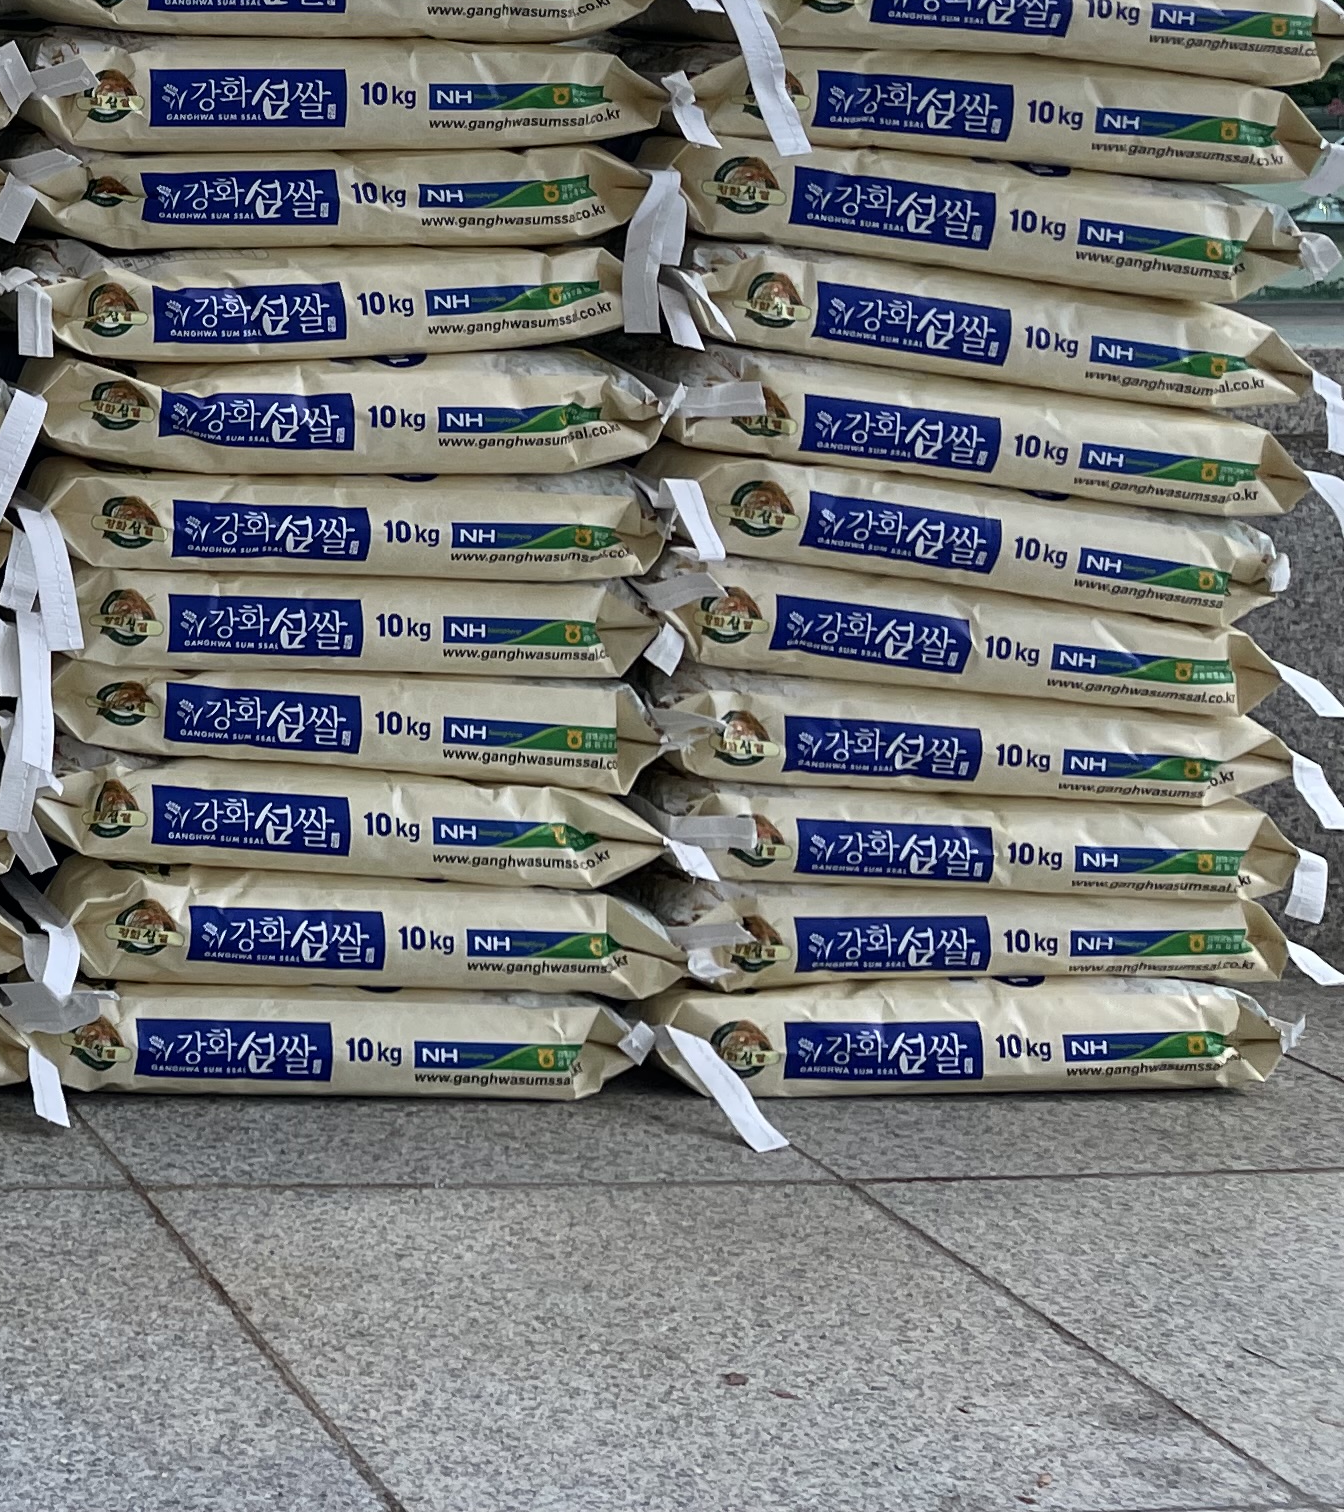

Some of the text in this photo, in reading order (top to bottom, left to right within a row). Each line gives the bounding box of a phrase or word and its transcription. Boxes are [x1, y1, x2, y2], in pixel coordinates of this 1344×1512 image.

[166, 113, 262, 121] GANGHWA SUM SSAL
[190, 76, 332, 119] 강화섬쌀
[436, 90, 472, 104] NH
[857, 83, 997, 132] 강화섬쌀
[1103, 113, 1140, 130] NH
[194, 293, 332, 335] 강화섬쌀
[433, 294, 470, 310] NH
[839, 412, 985, 464] 강화섬쌀
[1087, 449, 1124, 468] NH
[209, 604, 348, 650] 강화섬쌀
[450, 622, 486, 638] NH
[813, 612, 955, 665] 강화섬쌀
[1059, 651, 1096, 669] NH
[168, 832, 264, 845] GANGHWA SUM SSAL
[192, 799, 334, 847] 강화섬쌀
[440, 823, 477, 841] NH
[837, 924, 976, 966] 강화섬쌀
[1077, 936, 1114, 951] NH
